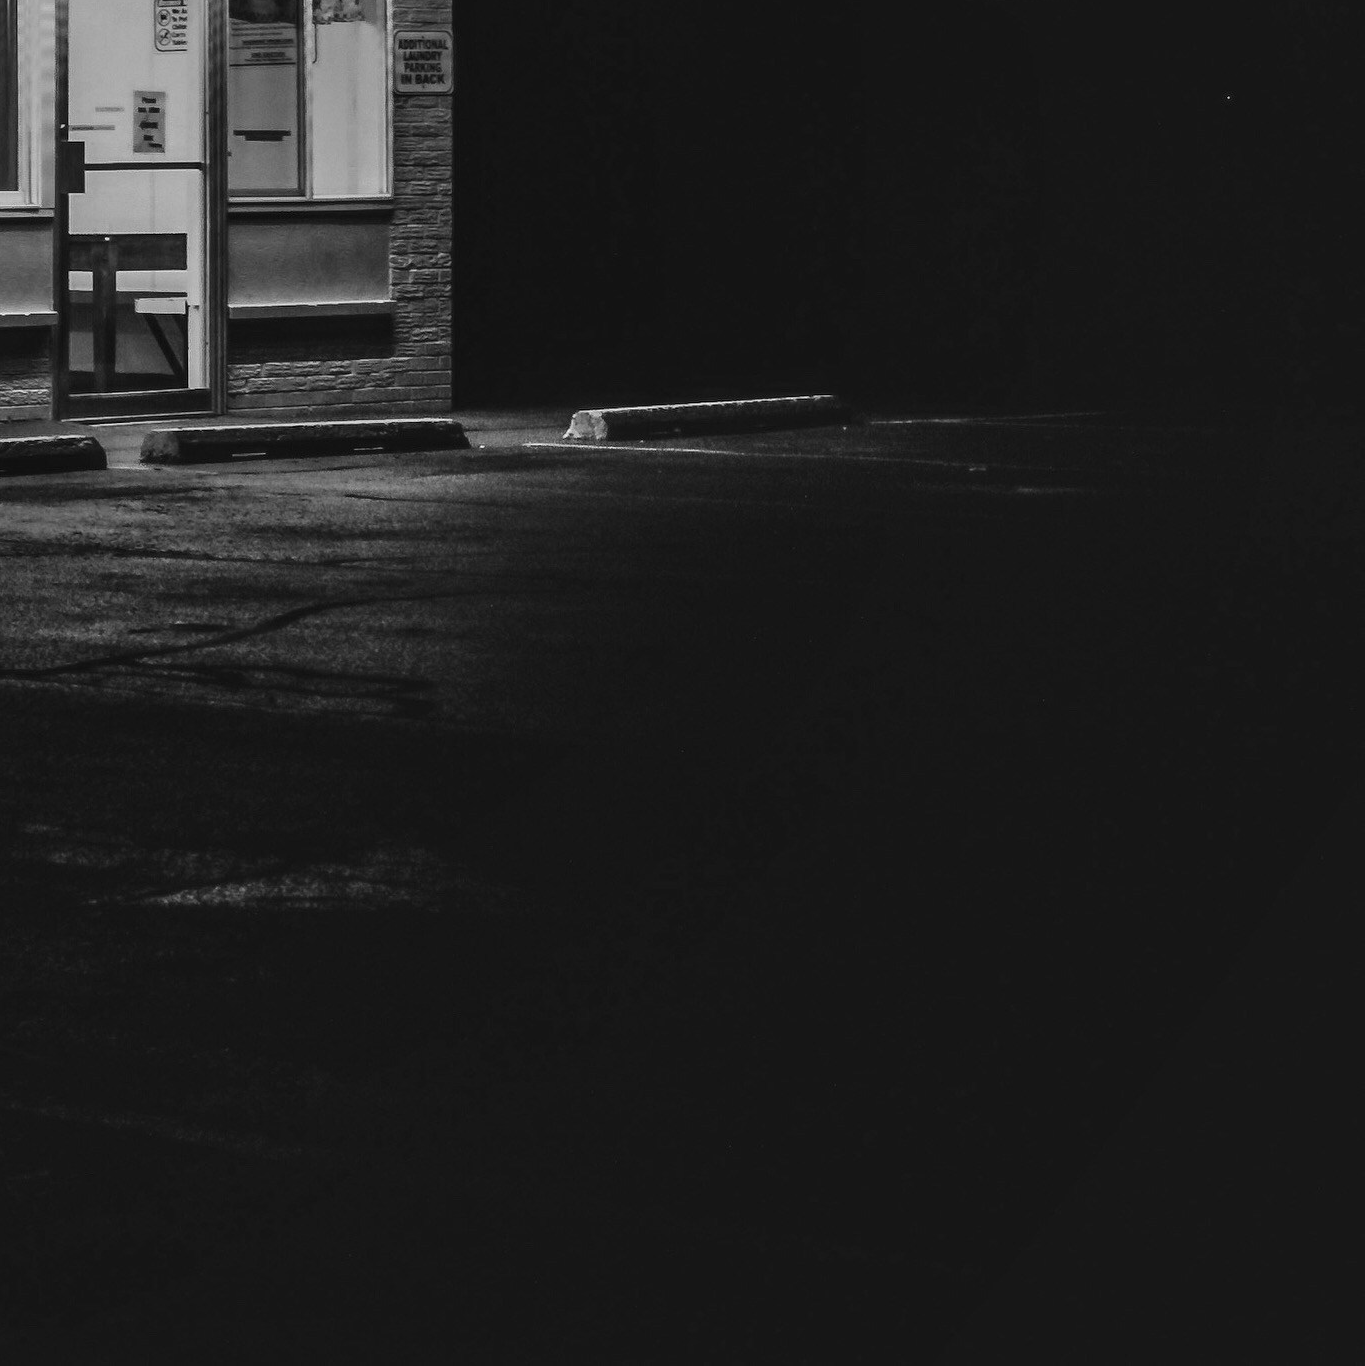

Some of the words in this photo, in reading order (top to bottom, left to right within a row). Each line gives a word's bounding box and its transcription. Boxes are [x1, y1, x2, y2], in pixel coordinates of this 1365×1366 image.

[398, 38, 449, 50] ADDITIONAL
[402, 50, 443, 62] LAUNDRY
[403, 62, 443, 73] PARKING
[400, 74, 412, 85] IN
[415, 74, 447, 84] BACK
